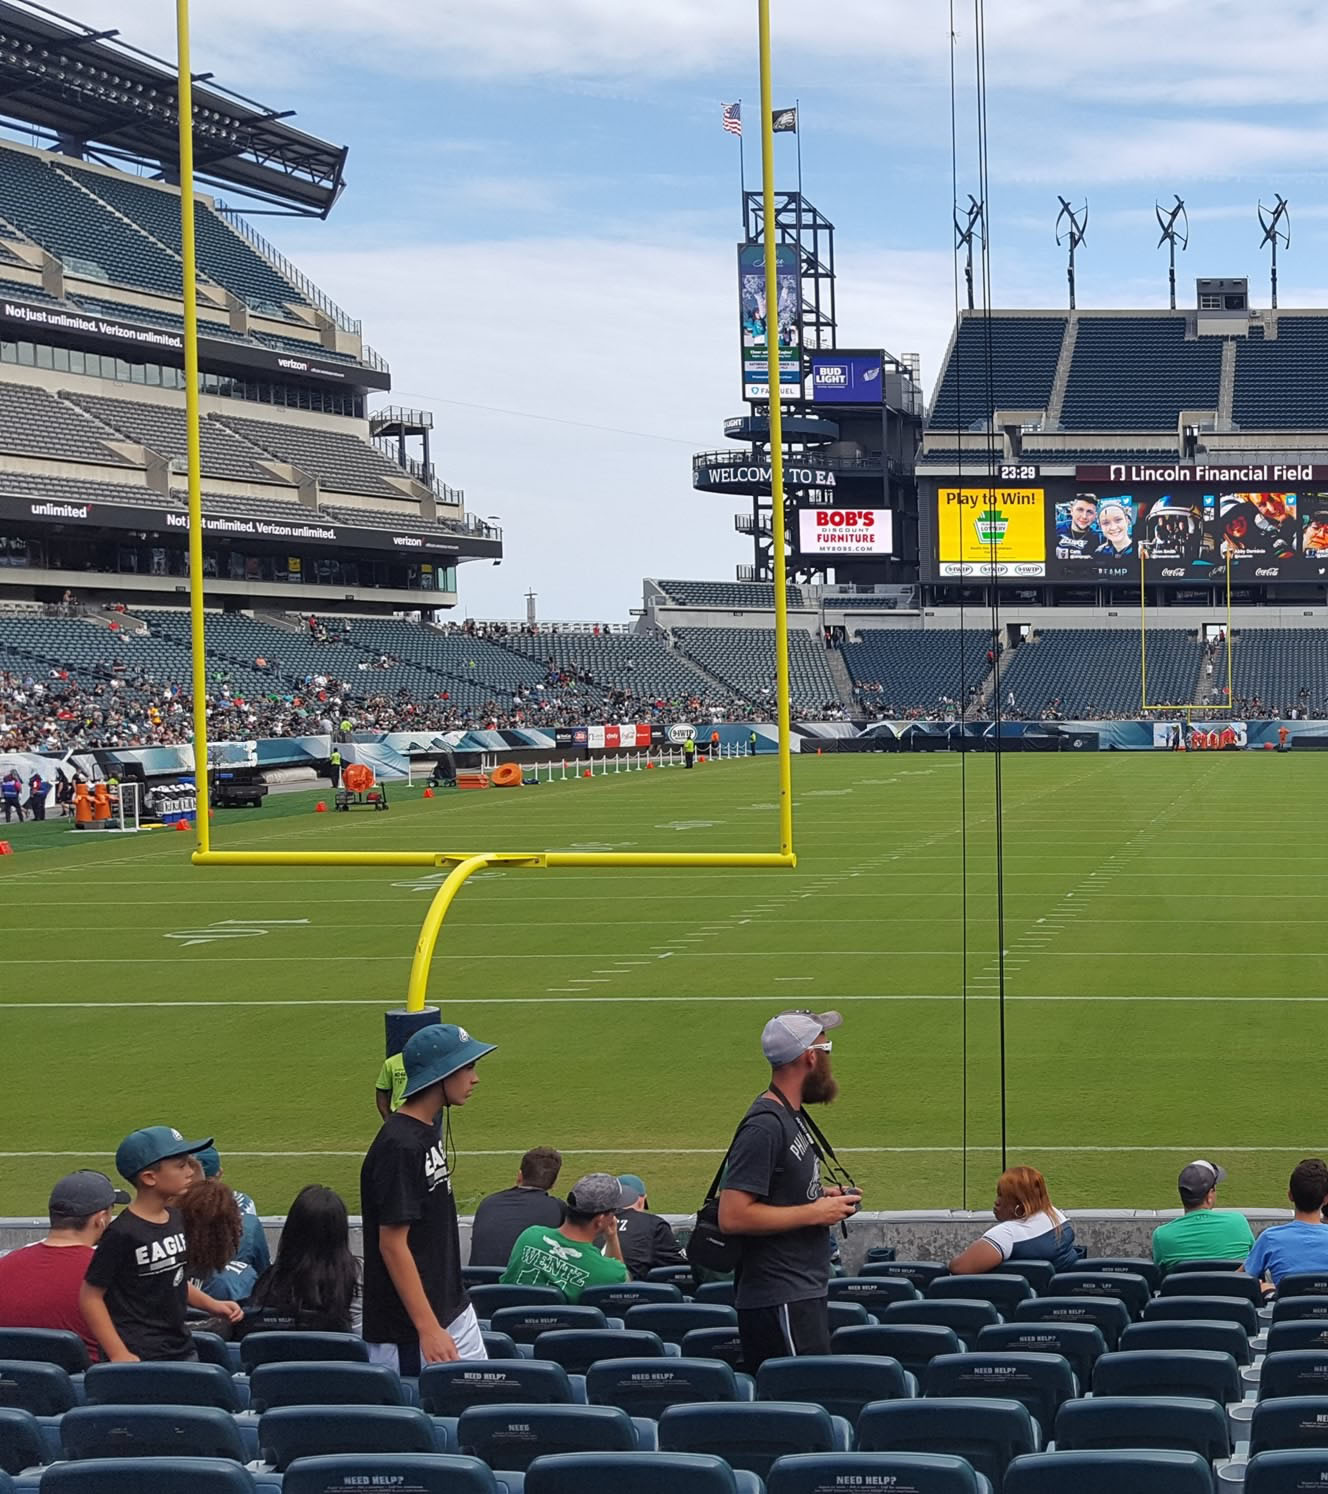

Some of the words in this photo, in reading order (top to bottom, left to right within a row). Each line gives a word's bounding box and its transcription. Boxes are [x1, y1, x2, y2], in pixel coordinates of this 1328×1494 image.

[5, 304, 26, 319] Not
[26, 307, 47, 323] just
[47, 311, 98, 332] unlimited.
[99, 322, 137, 339] Verizon
[137, 330, 183, 348] unlimited.
[278, 357, 307, 371] verizon
[820, 367, 842, 375] BUD
[816, 375, 846, 383] LIGHT
[709, 467, 785, 483] WELCOM
[789, 469, 812, 483] TO
[816, 471, 836, 486] EA
[1001, 467, 1036, 479] 23:29
[1131, 466, 1190, 480] Lincoln
[1196, 465, 1267, 480] Financial
[1274, 465, 1313, 480] Field
[946, 492, 979, 508] Play
[983, 493, 998, 505] to
[1002, 492, 1035, 505] Win!
[31, 503, 87, 518] unlimited
[816, 510, 875, 527] BOB'S
[166, 514, 185, 527] Not
[207, 519, 255, 533] unlimited.
[256, 522, 292, 535] Verizon
[292, 526, 337, 539] unlimited.
[393, 536, 422, 547] verizon
[817, 534, 875, 543] FURNITURE
[522, 1245, 590, 1288] WENTZ
[464, 1372, 481, 1380] NEED
[484, 1372, 506, 1380] HELP?
[344, 1476, 370, 1485] NEED
[372, 1476, 404, 1485] HELP?
[836, 1475, 862, 1485] NEED
[865, 1475, 896, 1485] HELP?
